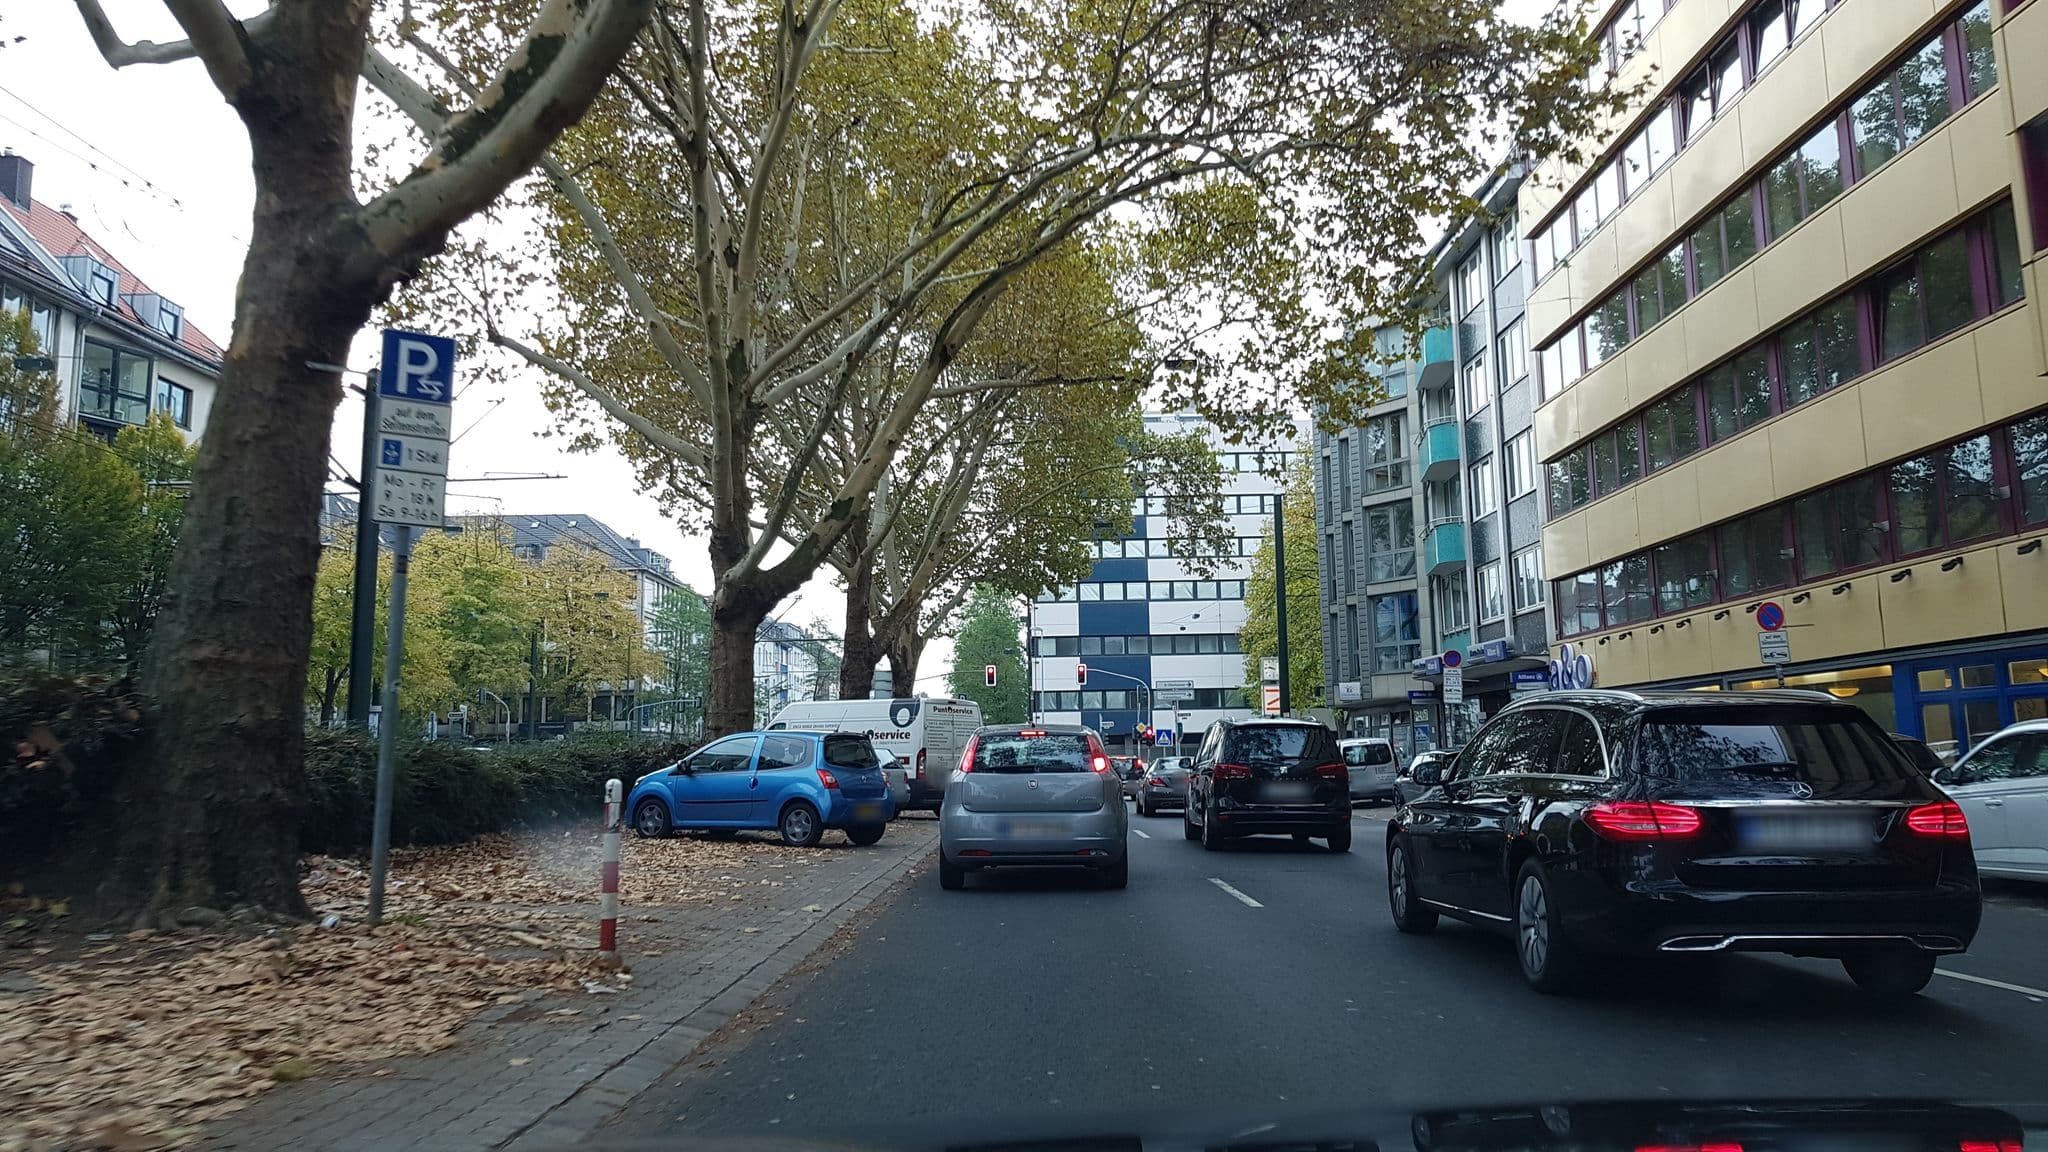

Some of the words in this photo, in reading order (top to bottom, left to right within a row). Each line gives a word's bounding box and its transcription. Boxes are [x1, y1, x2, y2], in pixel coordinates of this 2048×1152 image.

[396, 338, 438, 395] P
[384, 474, 404, 488] Mo
[421, 478, 436, 490] Fr
[377, 504, 395, 518] Sa
